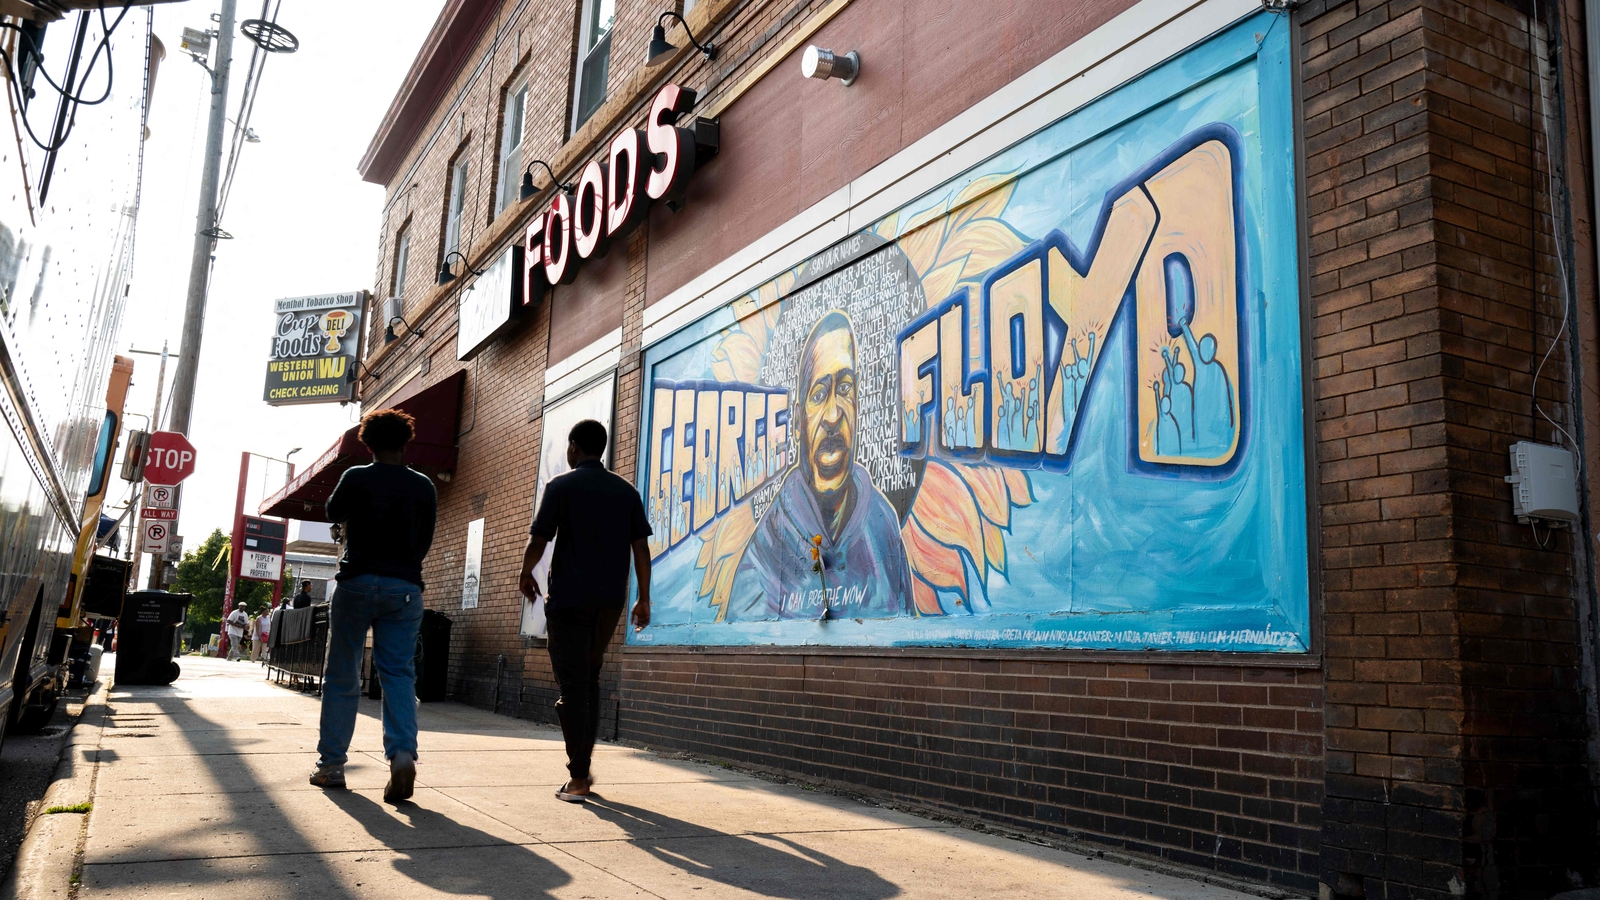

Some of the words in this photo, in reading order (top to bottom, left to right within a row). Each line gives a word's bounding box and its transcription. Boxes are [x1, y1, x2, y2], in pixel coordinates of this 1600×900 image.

[522, 83, 684, 306] FOODS
[855, 250, 886, 278] JEREMY
[863, 261, 892, 286] CASTILE
[851, 280, 879, 304] FREDDIE
[880, 270, 900, 291] GREY
[276, 298, 305, 311] Menthol
[306, 295, 335, 308] Tobacco
[336, 294, 354, 305] Shop
[882, 292, 910, 316] TAYLOR
[899, 123, 1248, 481] FLOYD
[278, 312, 319, 338] Cup
[326, 318, 345, 332] DELI
[886, 305, 909, 328] DAVIS
[270, 334, 320, 358] Foods
[270, 360, 315, 372] WESTERN
[282, 370, 314, 382] UNION
[269, 387, 298, 399] CHECK
[300, 384, 339, 397] CASHING
[858, 408, 890, 432] TANISHA
[857, 424, 885, 446] TARIKA
[857, 441, 881, 463] ALTON
[647, 381, 789, 565] GEORGE
[876, 471, 917, 493] KATHRYN
[143, 510, 157, 518] ALL
[160, 510, 176, 519] WAY
[255, 553, 271, 563] PEOPLE
[256, 562, 267, 570] OVER
[250, 569, 273, 579] PROPERTY!
[781, 594, 786, 611] I
[788, 590, 806, 611] CAN
[842, 584, 868, 606] NOW
